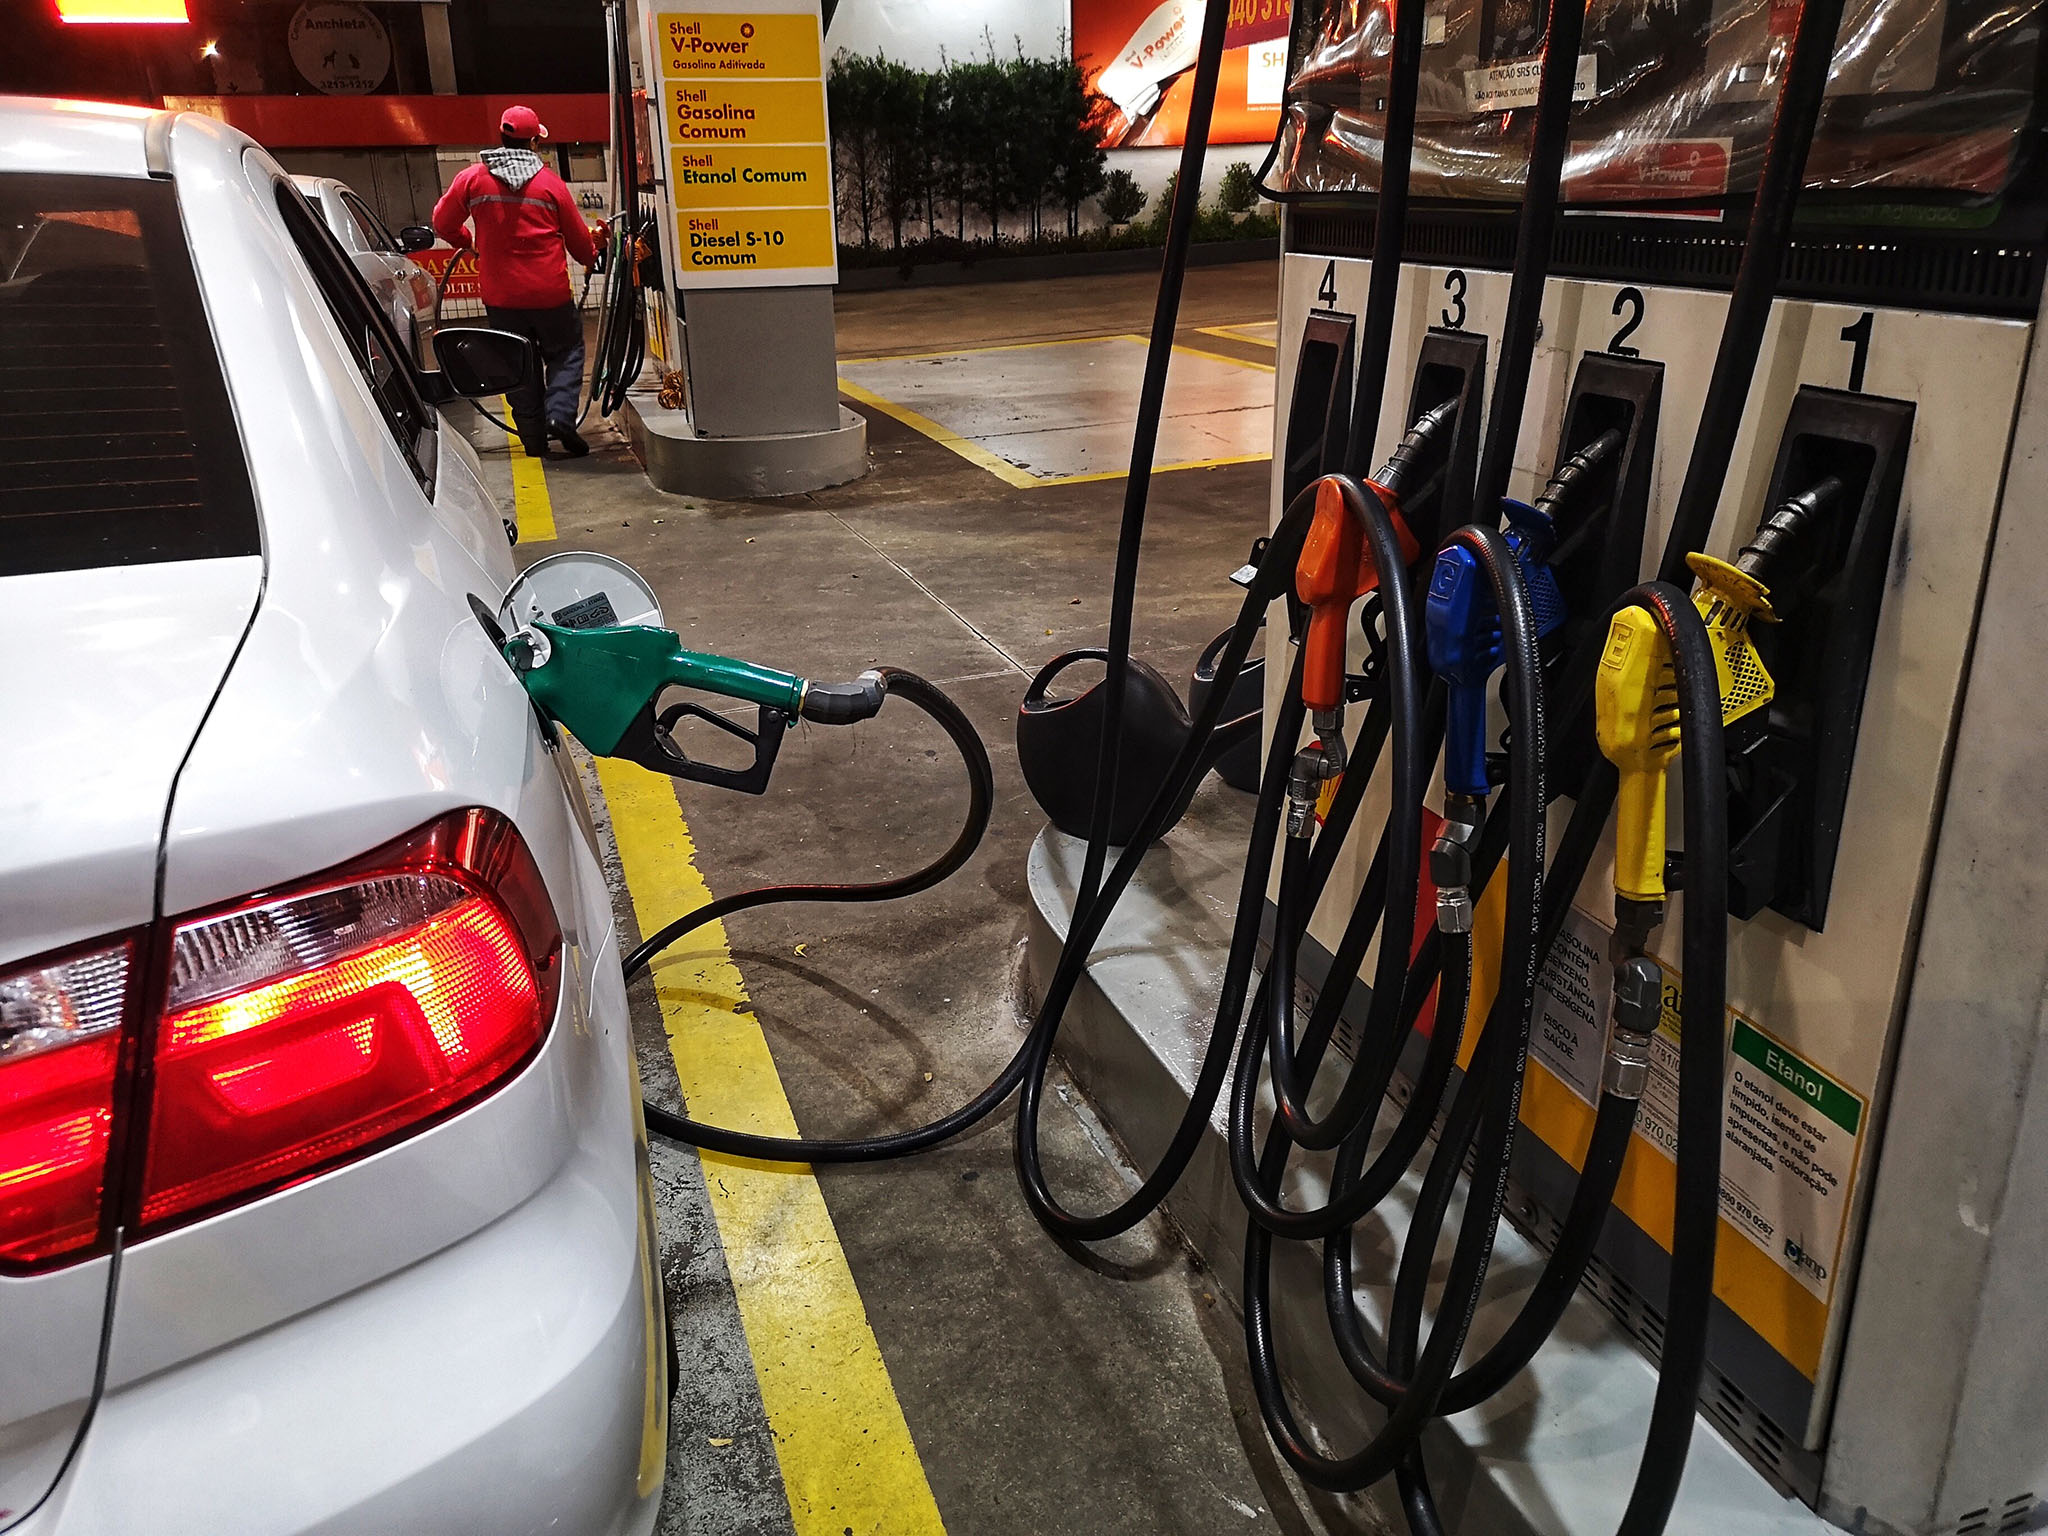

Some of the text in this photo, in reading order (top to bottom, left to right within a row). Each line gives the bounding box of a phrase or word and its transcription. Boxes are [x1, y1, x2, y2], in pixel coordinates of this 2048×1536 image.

[305, 18, 366, 30] Anchieta
[669, 22, 701, 35] Shell
[671, 37, 749, 54] V-Power
[1130, 15, 1185, 68] V-Power
[673, 59, 765, 69] Gasolina Aditivada
[1489, 66, 1515, 81] ATENÇÃO
[1517, 65, 1530, 77] SRS
[676, 89, 707, 102] Shell
[677, 104, 755, 120] Gasolina
[679, 123, 746, 139] Comum
[682, 154, 713, 167] Shell
[683, 167, 807, 184] Etanol Comum
[1638, 166, 1694, 182] V-Power
[688, 218, 719, 231] Shell
[690, 230, 784, 248] Diesel S-10
[691, 251, 757, 266] Comum
[440, 282, 476, 294] OLTE
[1318, 260, 1336, 309] 4
[1441, 269, 1468, 329] 3
[1608, 287, 1646, 358] 2
[1840, 312, 1875, 392] 1
[1605, 627, 1631, 664] E
[1552, 940, 1590, 973] CONTÉM
[1559, 929, 1600, 964] ASOLINA
[1663, 985, 1682, 1015] a
[1543, 1012, 1571, 1040] RISCO
[1765, 1049, 1824, 1102] Etanol
[1734, 1071, 1828, 1143] O etanol deve estar
[1645, 1117, 1664, 1139] 970
[1771, 1113, 1802, 1142] isento
[1804, 1139, 1817, 1153] de
[1725, 1130, 1775, 1173] alaranjada.
[1727, 1115, 1778, 1157] apresentar
[1779, 1154, 1828, 1197] coloração
[1730, 1100, 1838, 1187] impurezas, e não pode
